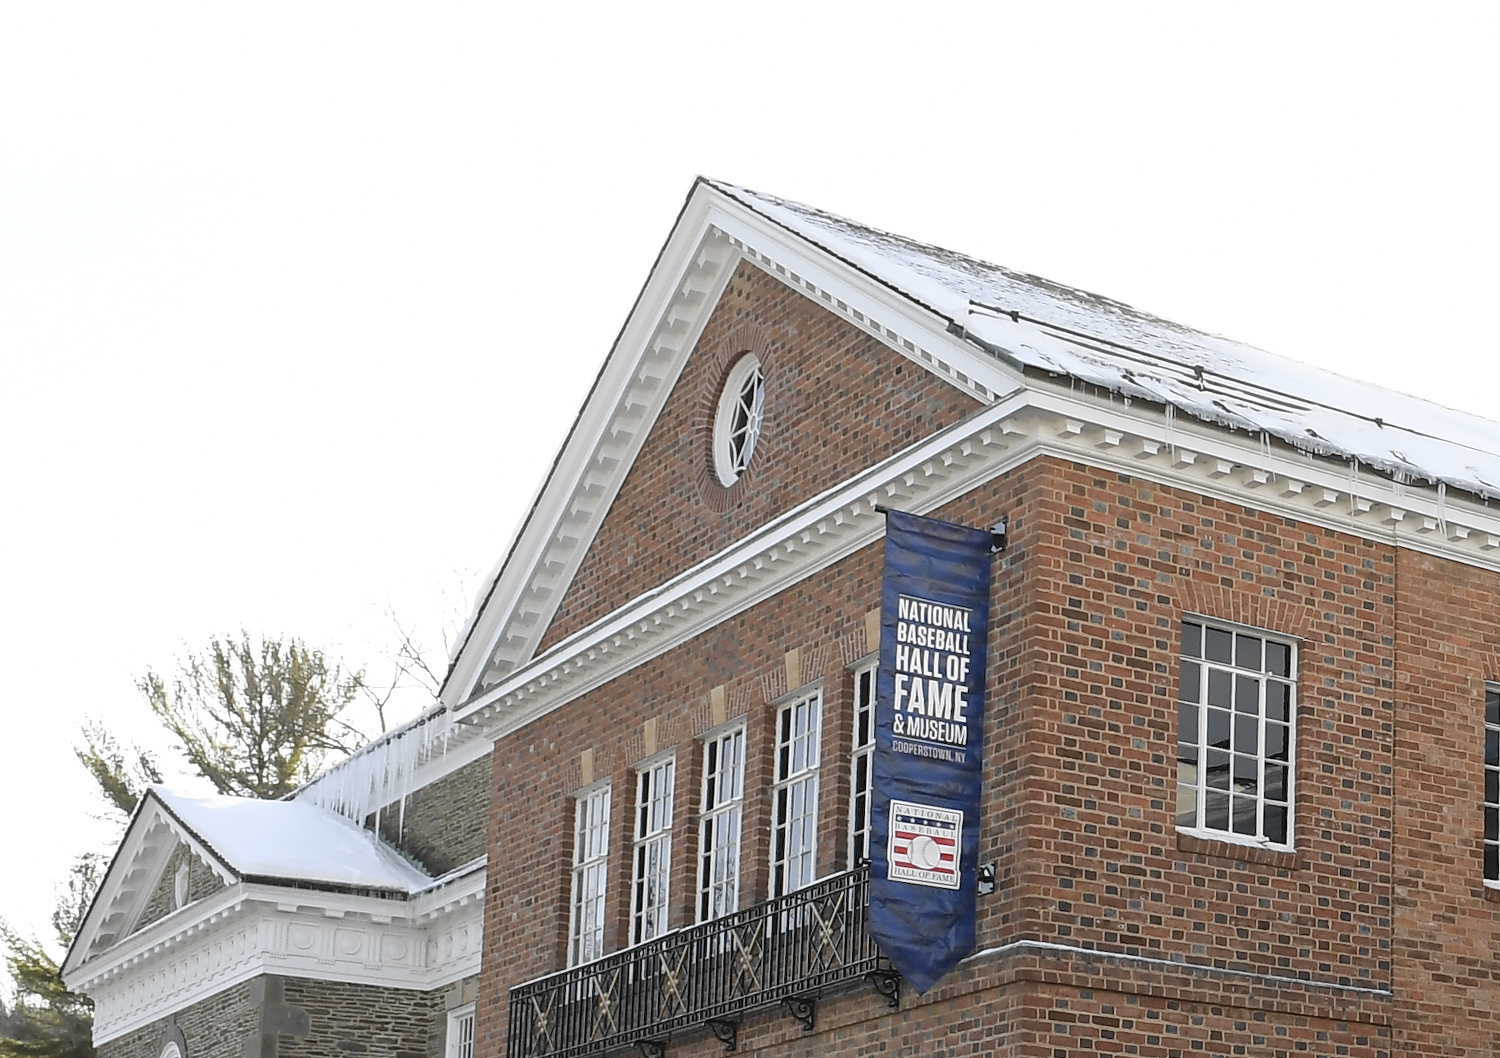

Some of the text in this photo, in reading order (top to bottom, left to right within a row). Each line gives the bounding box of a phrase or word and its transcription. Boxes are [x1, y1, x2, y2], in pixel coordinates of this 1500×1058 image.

[898, 597, 972, 633] NATIONAL
[897, 621, 971, 655] BASEBALL
[895, 644, 970, 683] HALL OF
[893, 673, 969, 723] FAME
[893, 713, 968, 746] & MUSEUM
[892, 740, 966, 764] COOPERSTOWN, NY
[895, 805, 957, 822] NATIONAL
[895, 822, 956, 838] BASEBALL
[894, 867, 955, 883] HALL OF FAME
